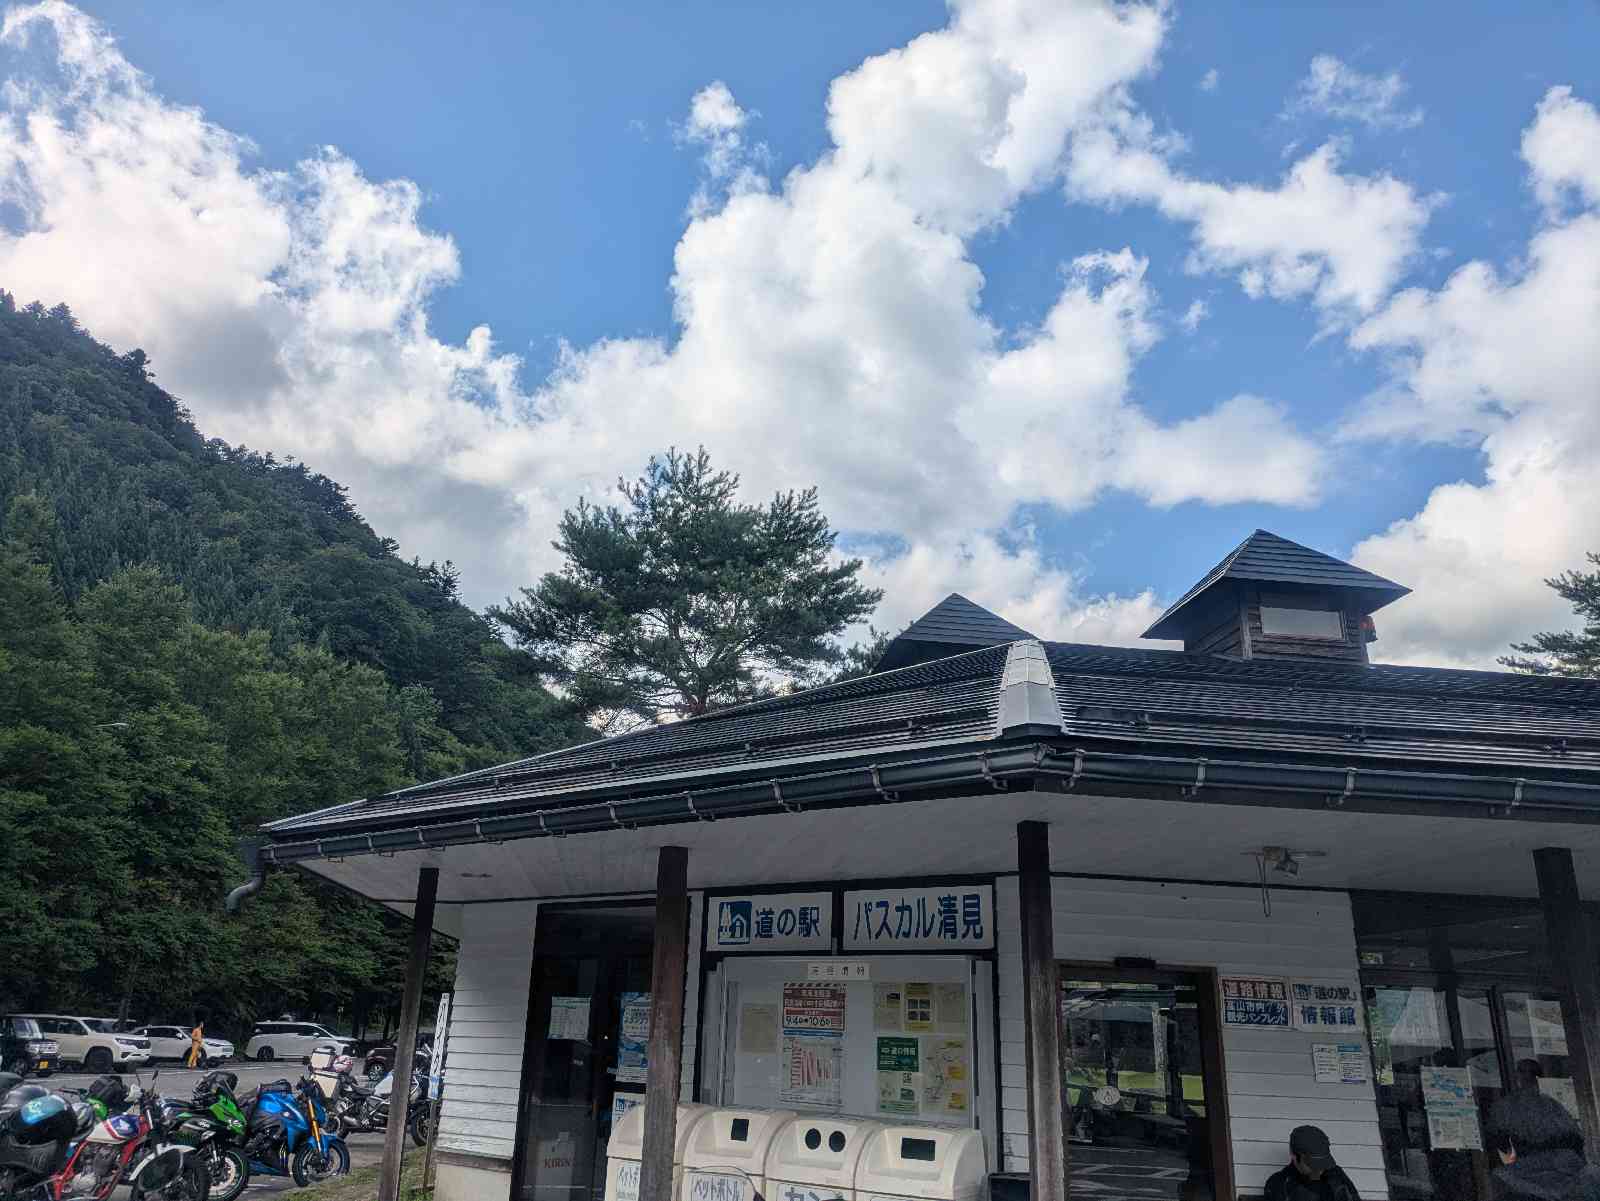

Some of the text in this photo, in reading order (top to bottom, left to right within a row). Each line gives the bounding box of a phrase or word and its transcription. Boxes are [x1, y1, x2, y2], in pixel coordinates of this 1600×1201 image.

[754, 905, 820, 939] 道の駅
[853, 894, 983, 940] パスカル清見
